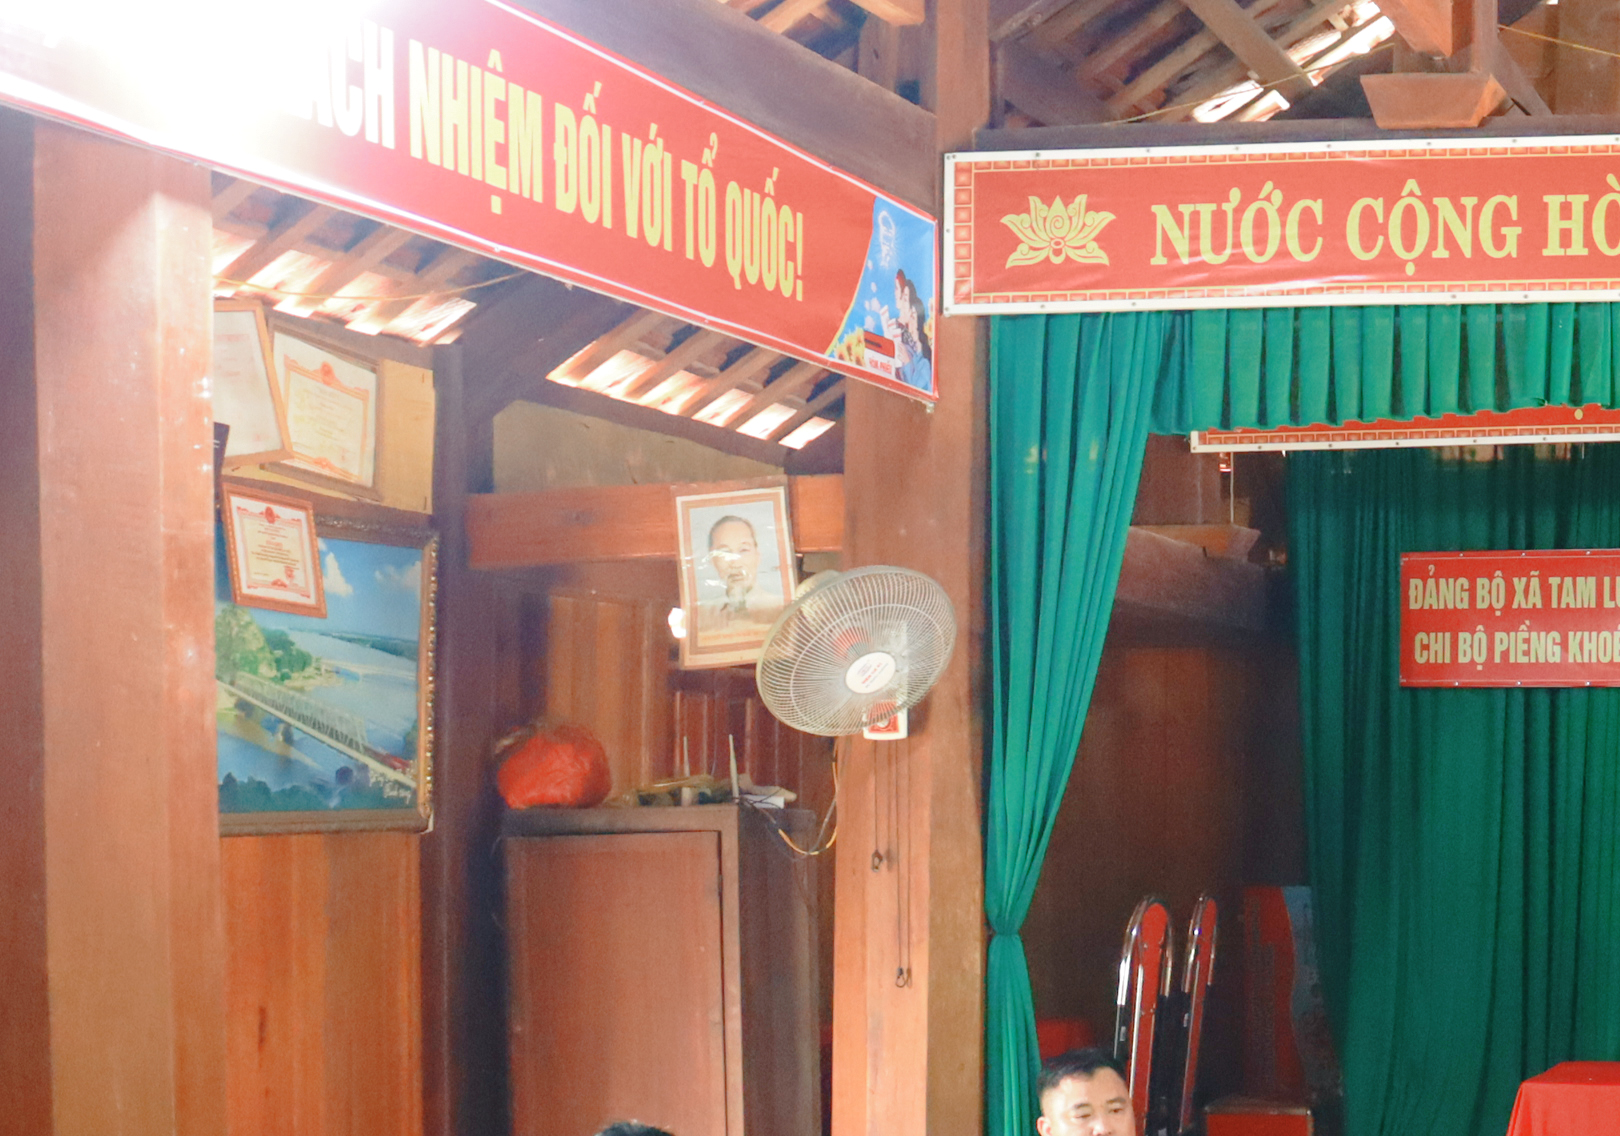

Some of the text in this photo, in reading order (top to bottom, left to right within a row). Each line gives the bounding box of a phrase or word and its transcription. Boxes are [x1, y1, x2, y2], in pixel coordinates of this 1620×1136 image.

[409, 38, 543, 215] NHIỆM
[554, 81, 612, 229] ĐỐI
[622, 122, 673, 252] VỚI
[681, 132, 718, 268] TỔ
[725, 167, 803, 302] QUỐC!
[1150, 180, 1325, 265] NƯỚC
[1345, 178, 1523, 276] CỘNG
[1408, 564, 1470, 610] ĐẢNG
[1476, 570, 1506, 617] BỘ
[1511, 570, 1543, 609] XÃ
[1548, 576, 1597, 609] TAM
[1414, 631, 1451, 664] CHI
[1457, 624, 1488, 671] BỘ
[1494, 619, 1562, 664] PIỀNG
